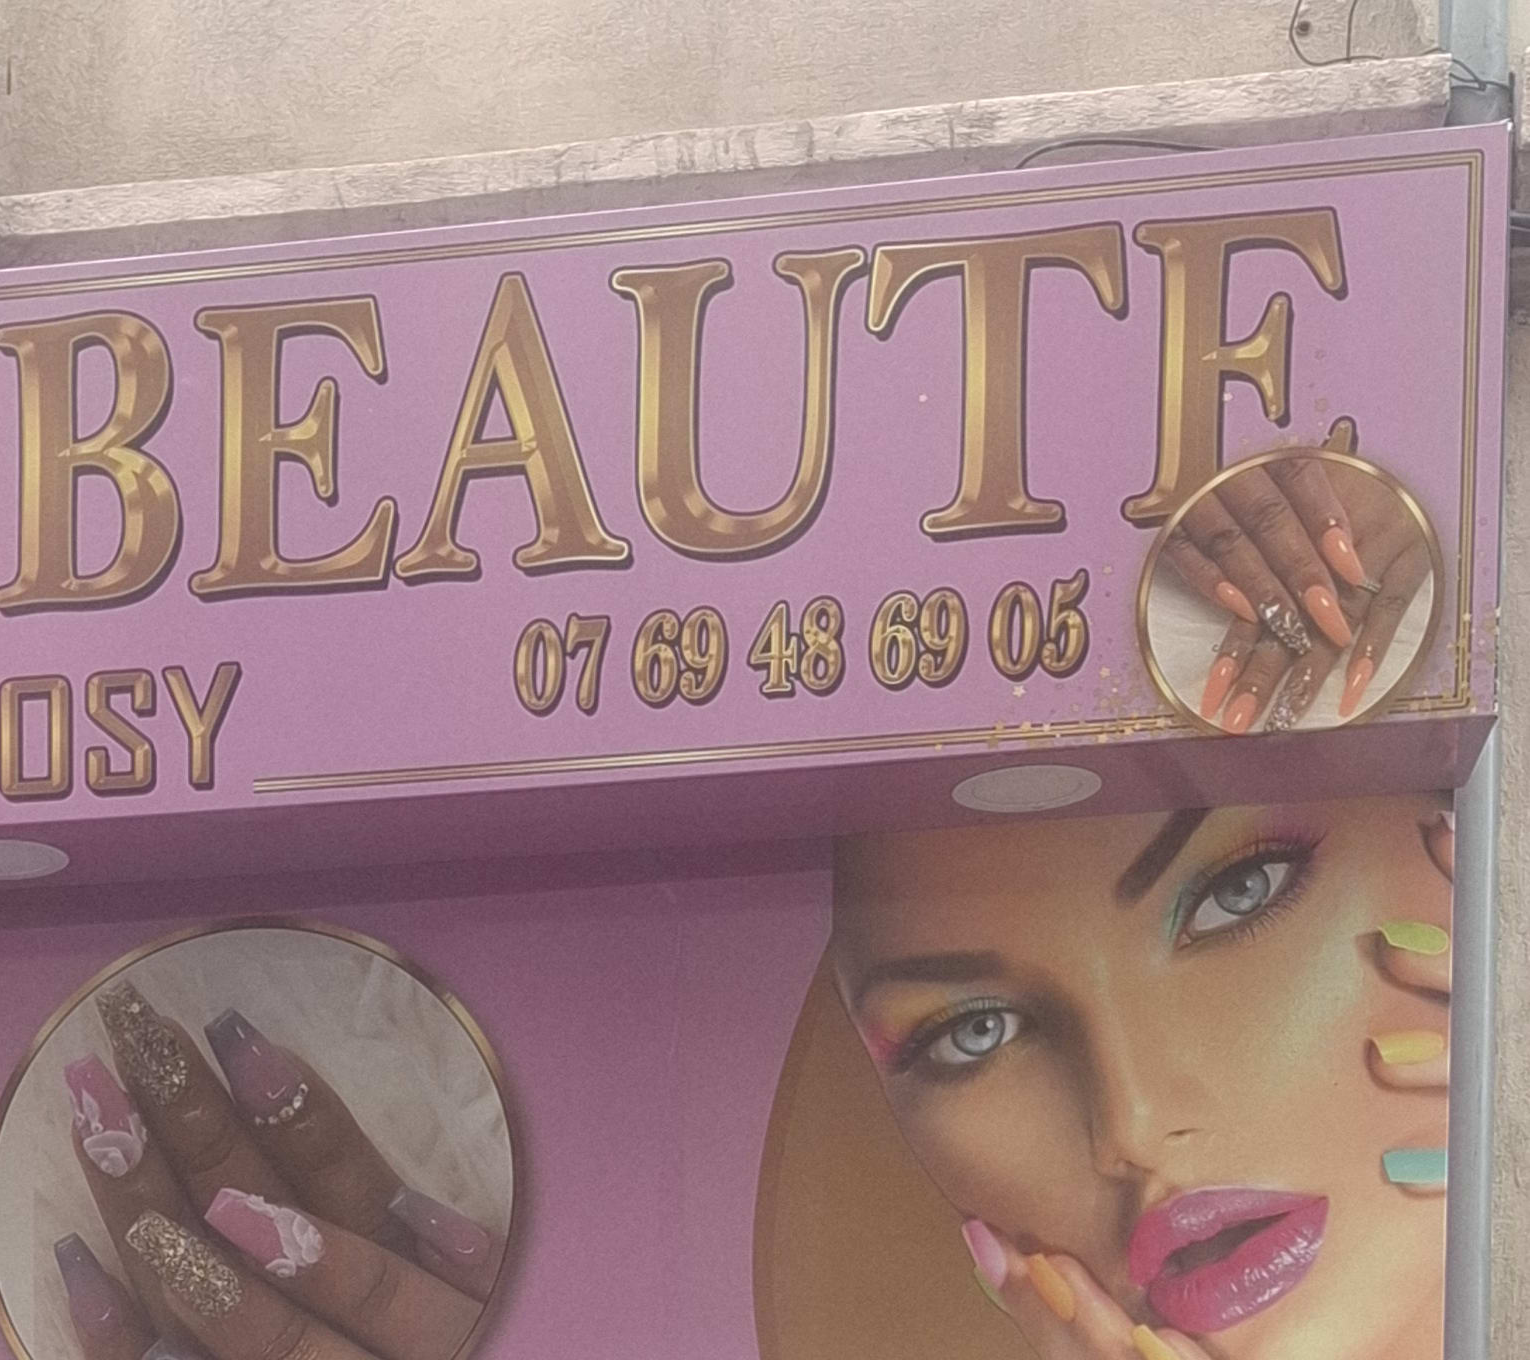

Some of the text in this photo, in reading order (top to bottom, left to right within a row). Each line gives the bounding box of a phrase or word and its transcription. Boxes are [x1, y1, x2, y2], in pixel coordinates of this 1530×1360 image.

[513, 567, 1090, 716] 07 69 48 69 05
